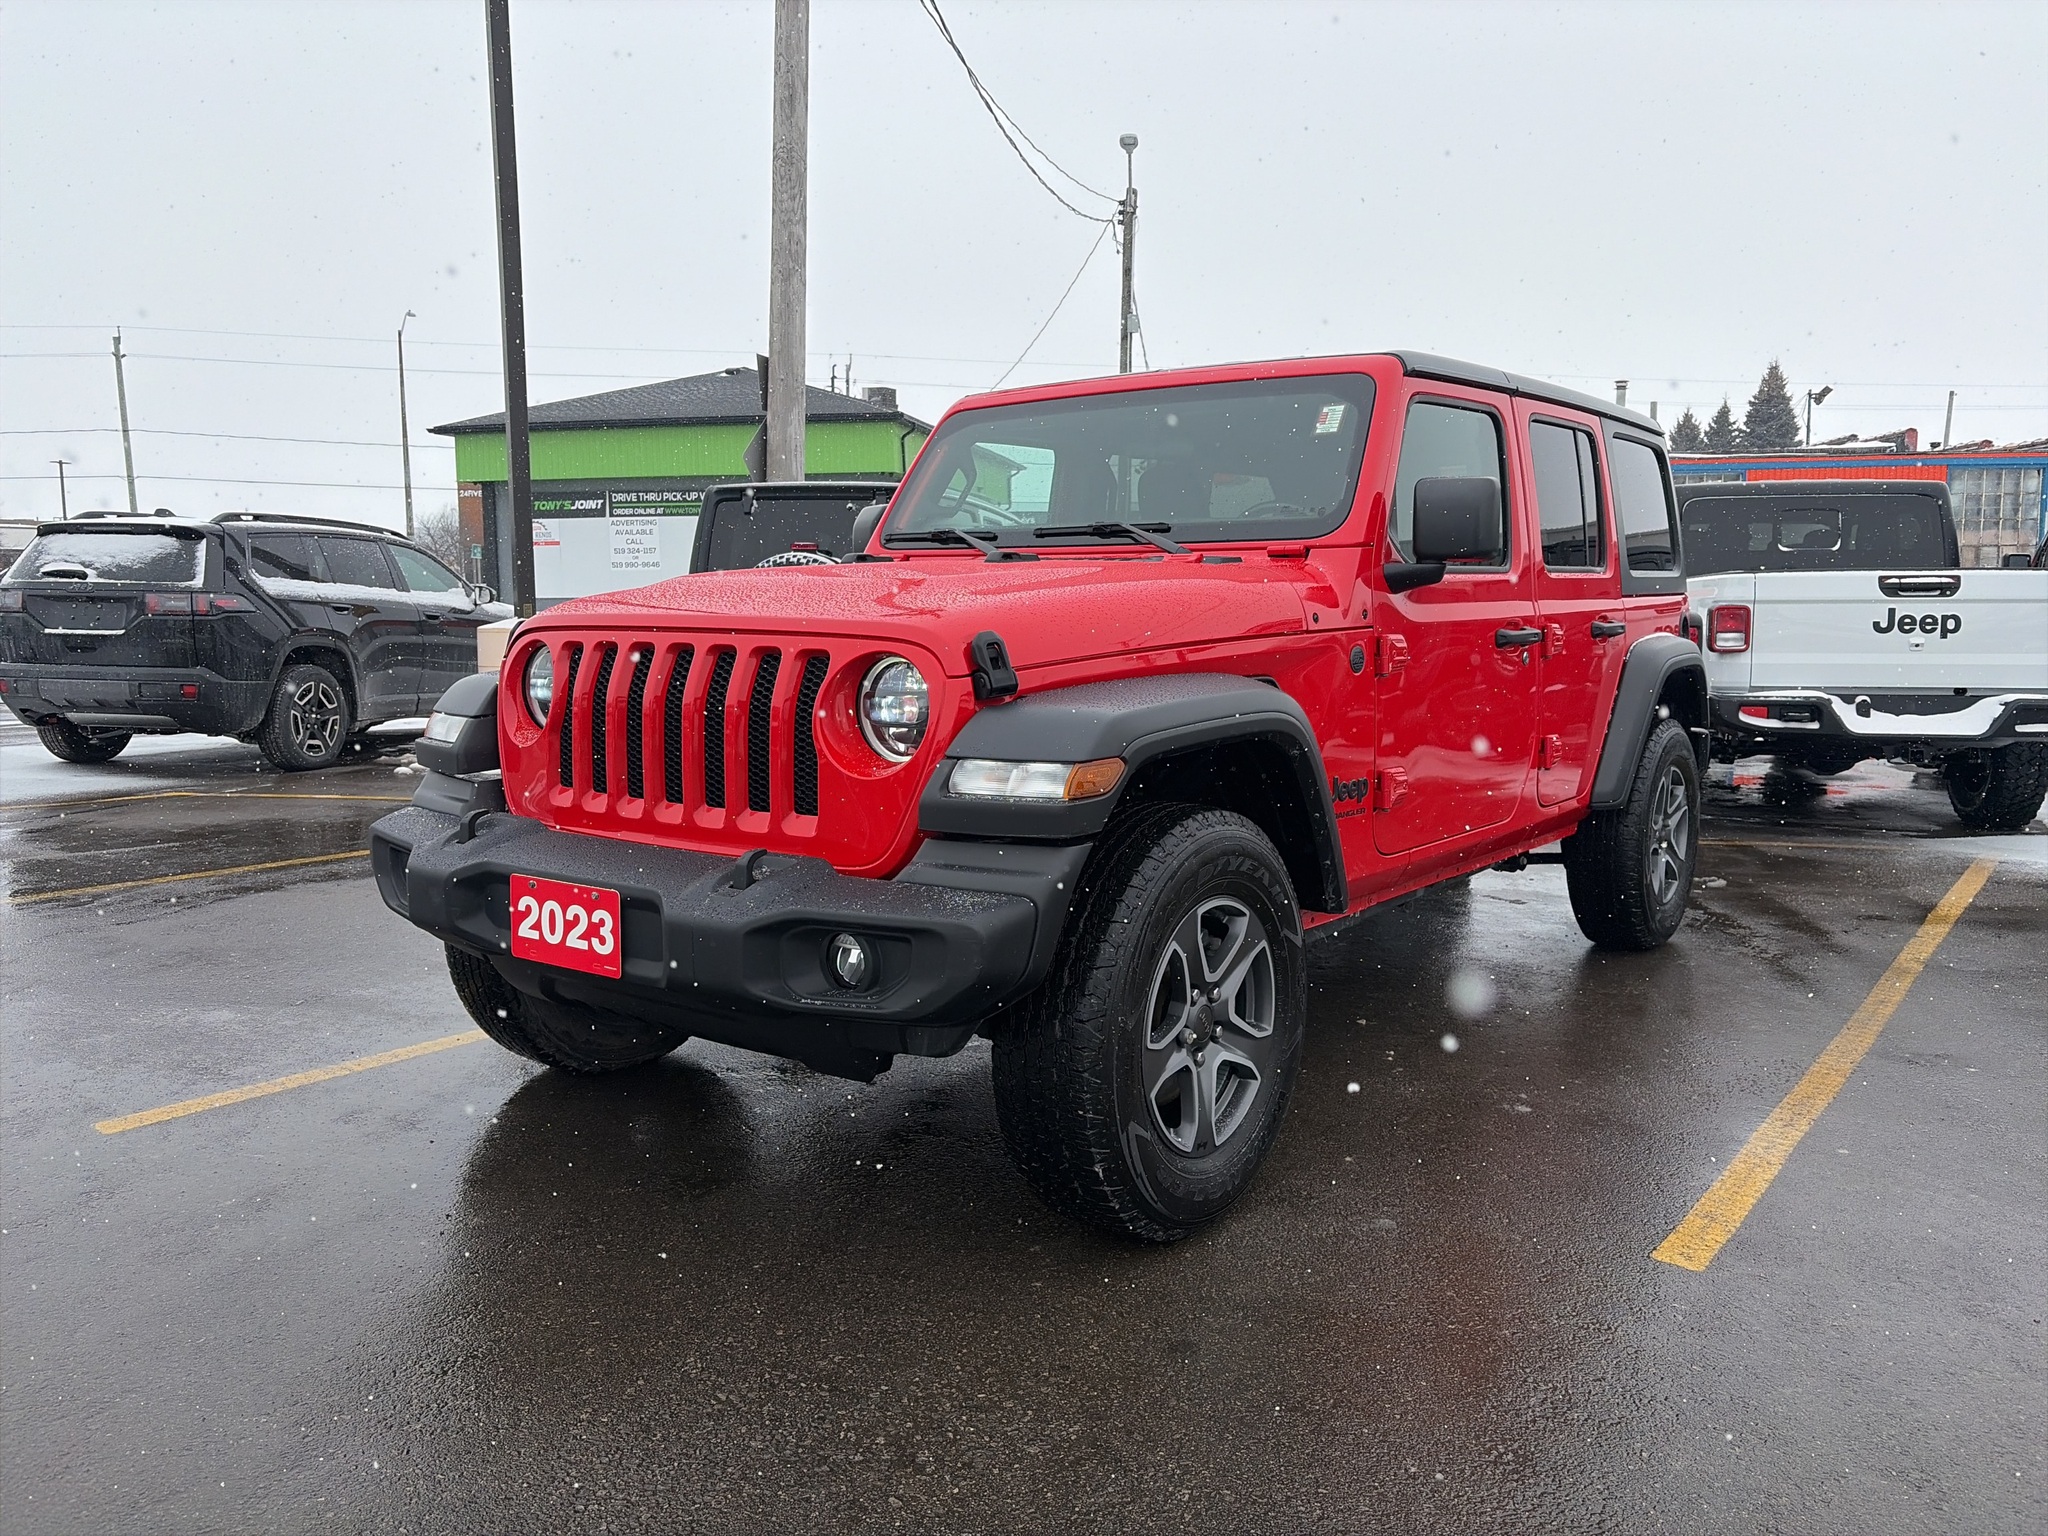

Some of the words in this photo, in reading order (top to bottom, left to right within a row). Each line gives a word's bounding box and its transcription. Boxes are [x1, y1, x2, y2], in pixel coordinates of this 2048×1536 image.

[611, 492, 637, 502] DRIVE
[638, 492, 662, 502] THRU
[663, 491, 699, 502] PICK-UP
[533, 500, 573, 511] TONY'S
[570, 499, 604, 510] JOINT
[612, 507, 634, 516] ORDER
[634, 507, 656, 515] ONLINE
[656, 507, 665, 515] AT
[610, 519, 658, 527] ADVERTISING
[614, 528, 654, 536] AVAILABLE
[613, 547, 626, 555] 519
[611, 561, 624, 569] 519
[1872, 607, 1962, 639] Jeep
[1331, 776, 1368, 803] Jeep
[1335, 807, 1366, 819] RANGLER
[517, 895, 615, 955] 2023
